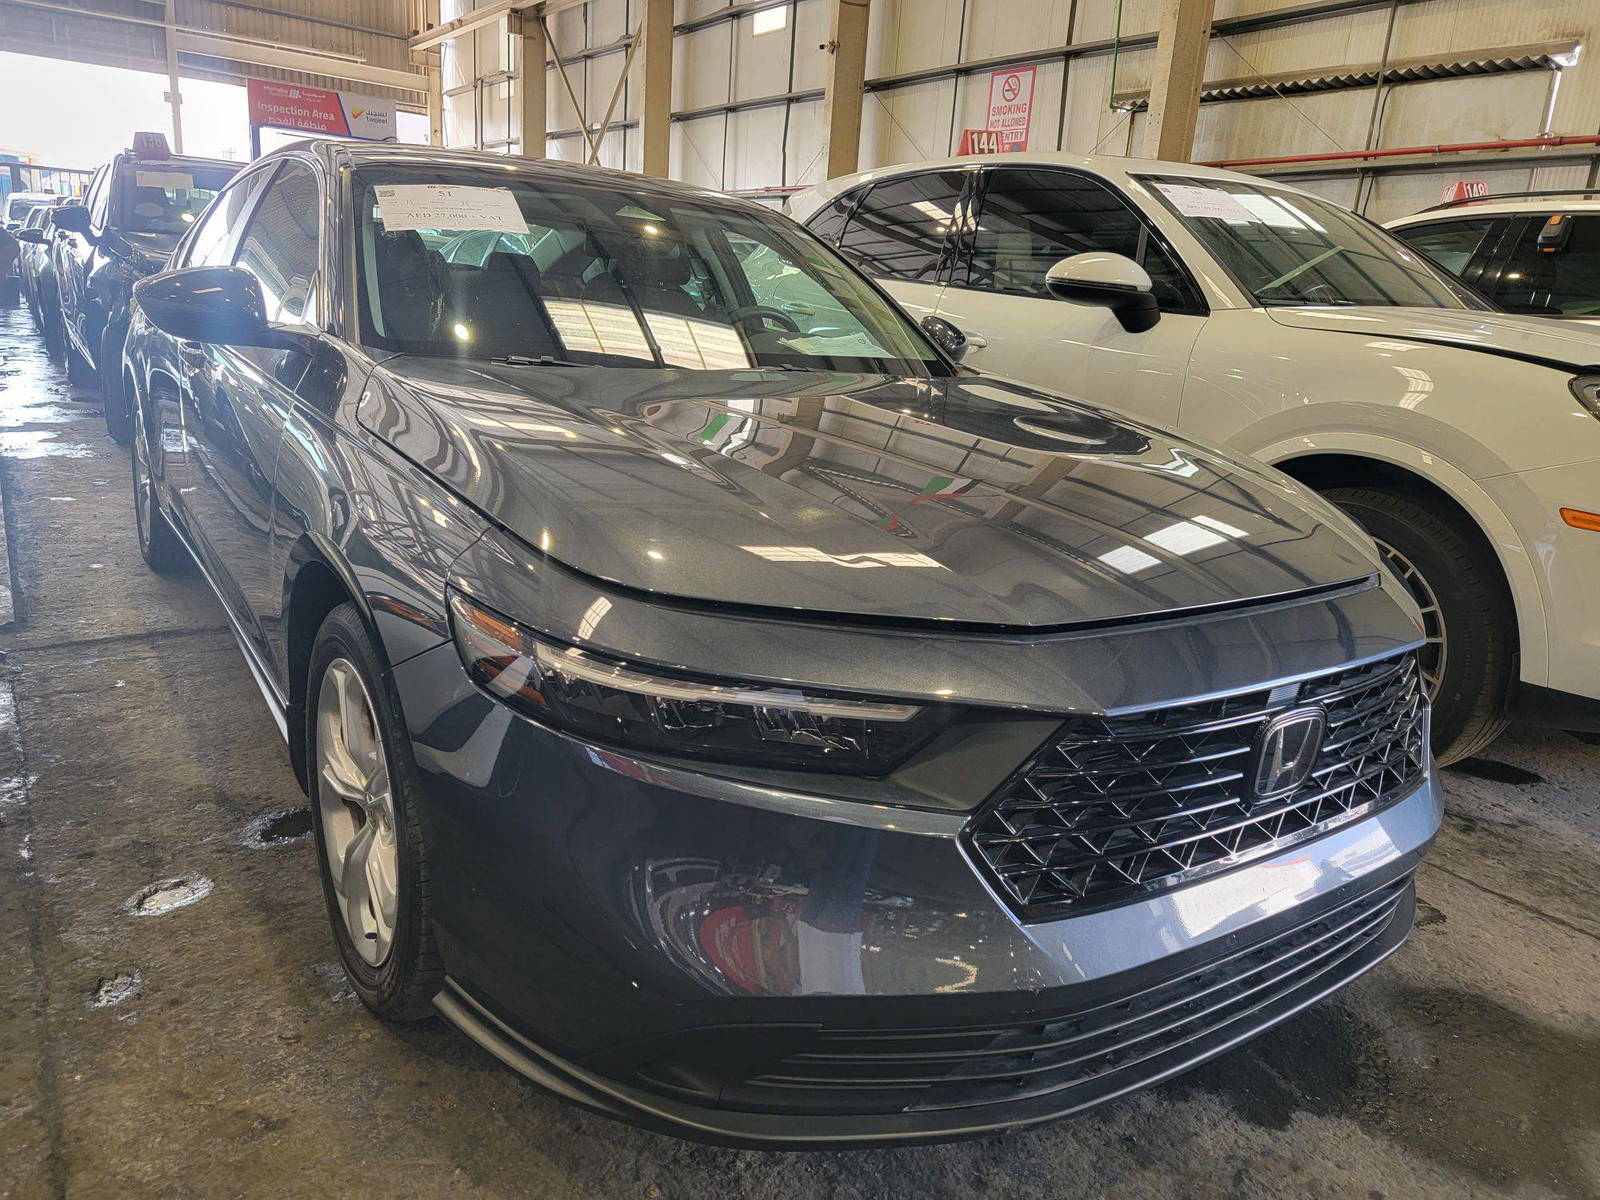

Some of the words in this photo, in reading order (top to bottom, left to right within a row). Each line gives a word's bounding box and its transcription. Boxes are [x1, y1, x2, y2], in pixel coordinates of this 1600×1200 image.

[257, 101, 310, 118] Inspection
[312, 109, 336, 121] Area
[991, 102, 1027, 117] SMOKING
[297, 119, 327, 131] منطقة
[366, 116, 388, 125] tasjeel
[990, 119, 1001, 129] NOT
[1001, 117, 1027, 128] ALLOWED
[971, 132, 999, 154] 144
